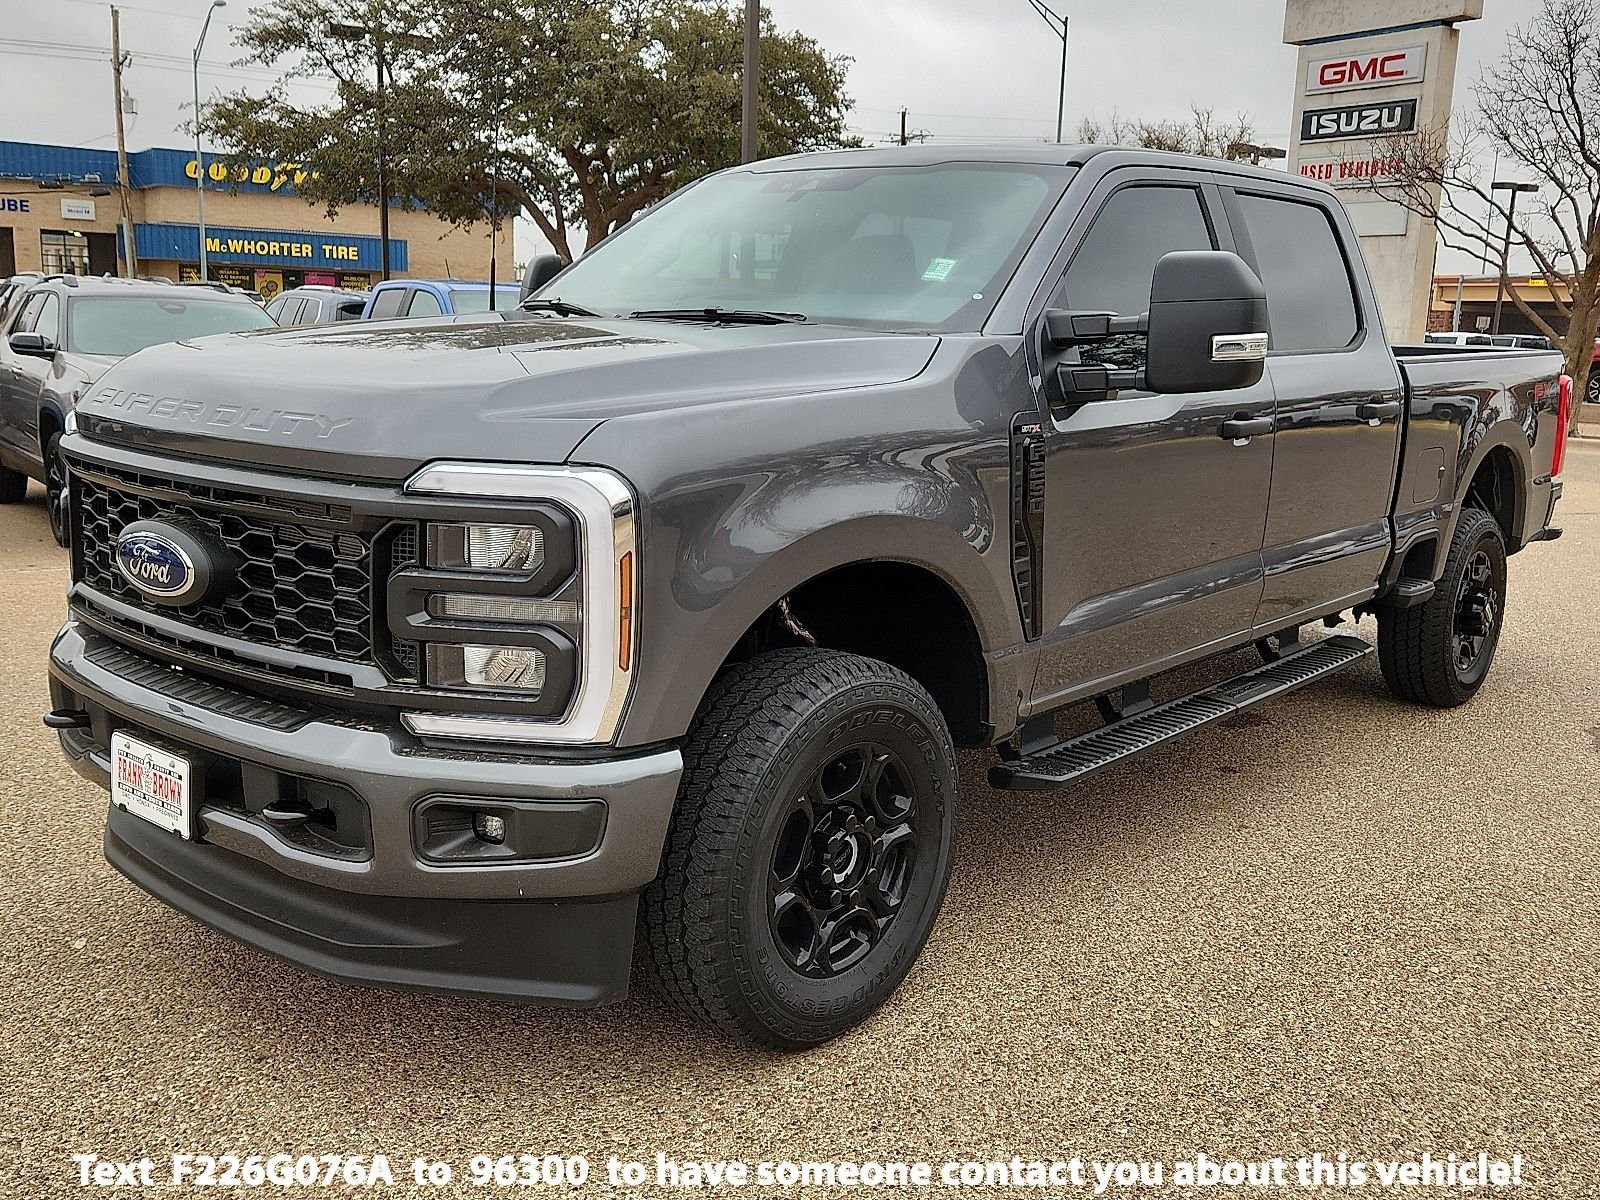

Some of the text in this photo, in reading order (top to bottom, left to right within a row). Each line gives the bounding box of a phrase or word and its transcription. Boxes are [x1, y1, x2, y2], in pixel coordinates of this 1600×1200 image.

[1319, 53, 1407, 86] GMC
[1310, 105, 1402, 135] ISUZU
[206, 237, 359, 261] McWHORTER TIRE
[92, 387, 354, 438] SUPER DUTY
[130, 543, 171, 584] Ford
[824, 709, 938, 765] DUELER
[118, 756, 144, 790] FRANK
[152, 771, 182, 807] BROWN
[757, 943, 907, 1018] BRIDGESTONE
